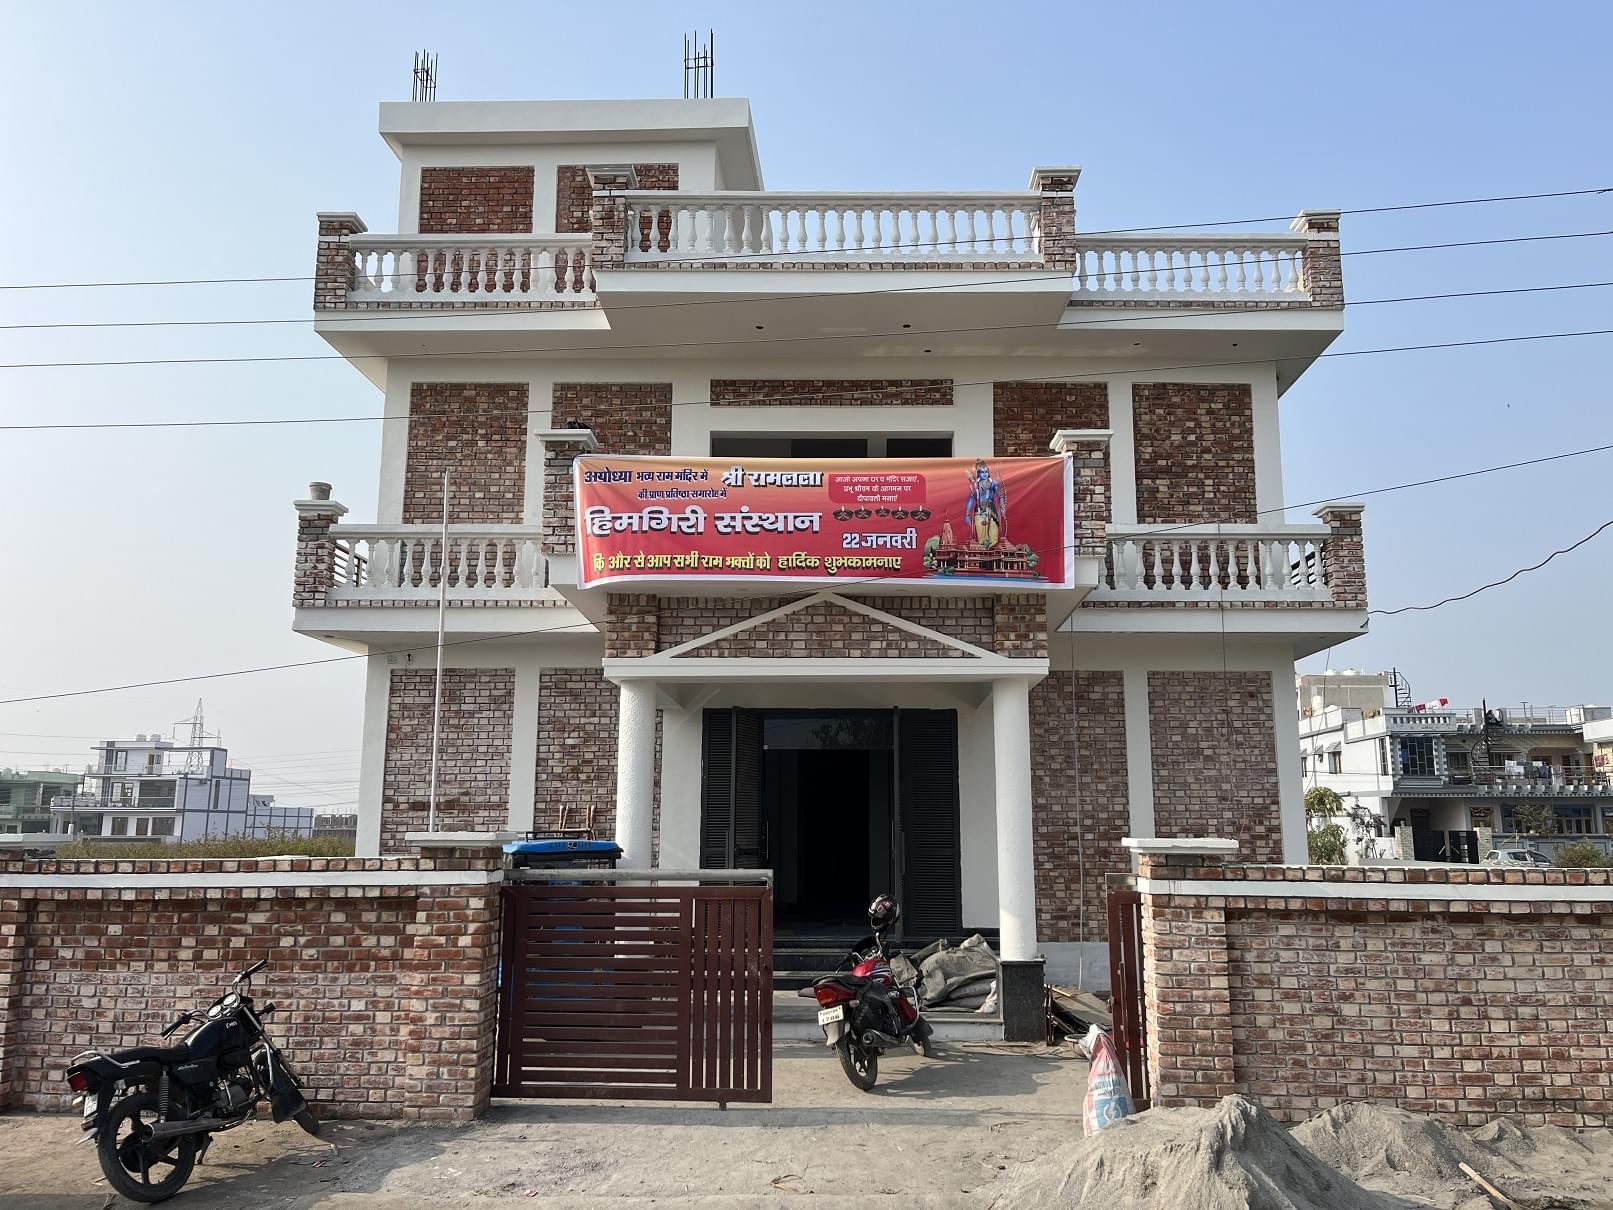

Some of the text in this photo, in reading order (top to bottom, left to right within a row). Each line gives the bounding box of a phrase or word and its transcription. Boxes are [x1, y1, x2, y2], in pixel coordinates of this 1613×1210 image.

[584, 467, 709, 483] अयोध्या भव्य राम मंदिर में
[720, 464, 824, 487] श्री रामलला
[638, 488, 728, 500] की प्राण प्रतिष्ठा समारोह में
[871, 484, 879, 492] के
[880, 484, 902, 492] आगमन
[584, 505, 823, 536] हिमगिरी संस्थान
[842, 527, 918, 549] 22 जनवरी
[608, 550, 631, 569] और
[633, 550, 645, 569] से
[647, 554, 672, 569] आप
[673, 550, 700, 569] सभी
[701, 554, 723, 570] राम
[725, 551, 755, 570] भक्तों
[756, 551, 771, 569] को
[778, 552, 821, 570] हार्दिक
[824, 556, 903, 574] शुभकामनाए
